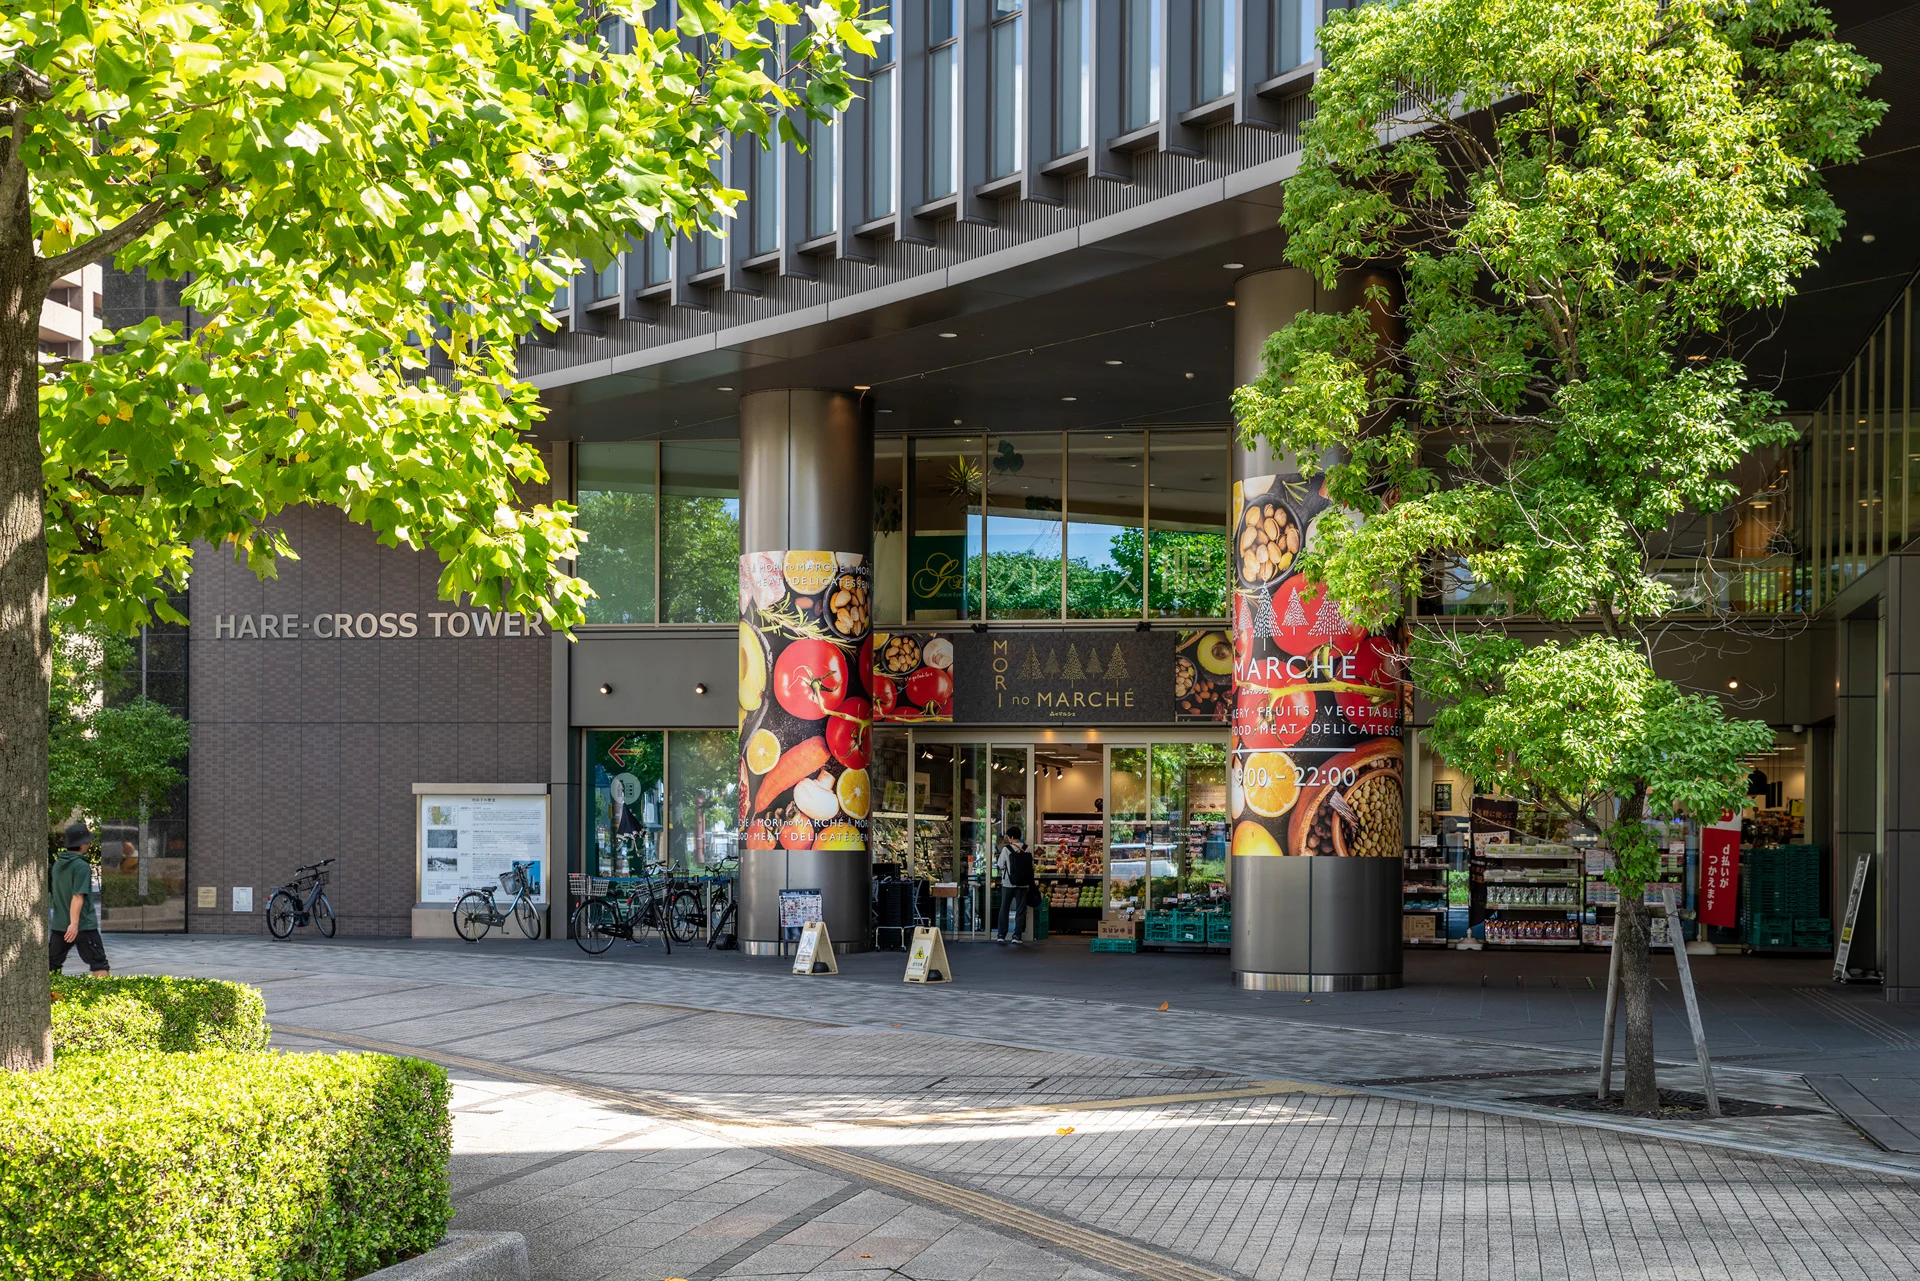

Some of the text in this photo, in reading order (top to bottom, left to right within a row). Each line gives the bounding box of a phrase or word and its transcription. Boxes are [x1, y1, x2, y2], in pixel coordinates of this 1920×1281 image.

[791, 576, 870, 589] DELICATESSEN
[427, 611, 546, 638] TOWER
[1233, 650, 1357, 682] MARCHÉ
[1012, 696, 1030, 705] no
[1037, 688, 1135, 708] MARCHÉ
[1257, 705, 1311, 718] FRUITS
[1323, 705, 1402, 719] VEGETABLES
[1259, 723, 1298, 735] MEAT
[1293, 766, 1357, 788] 22:00
[757, 818, 783, 828] MORI
[795, 817, 844, 828] MARCHÉ
[753, 832, 781, 841] MEAT
[790, 831, 870, 843] DELICATESSEN
[1719, 843, 1731, 889] d払いが
[1706, 855, 1718, 911] つかえます
